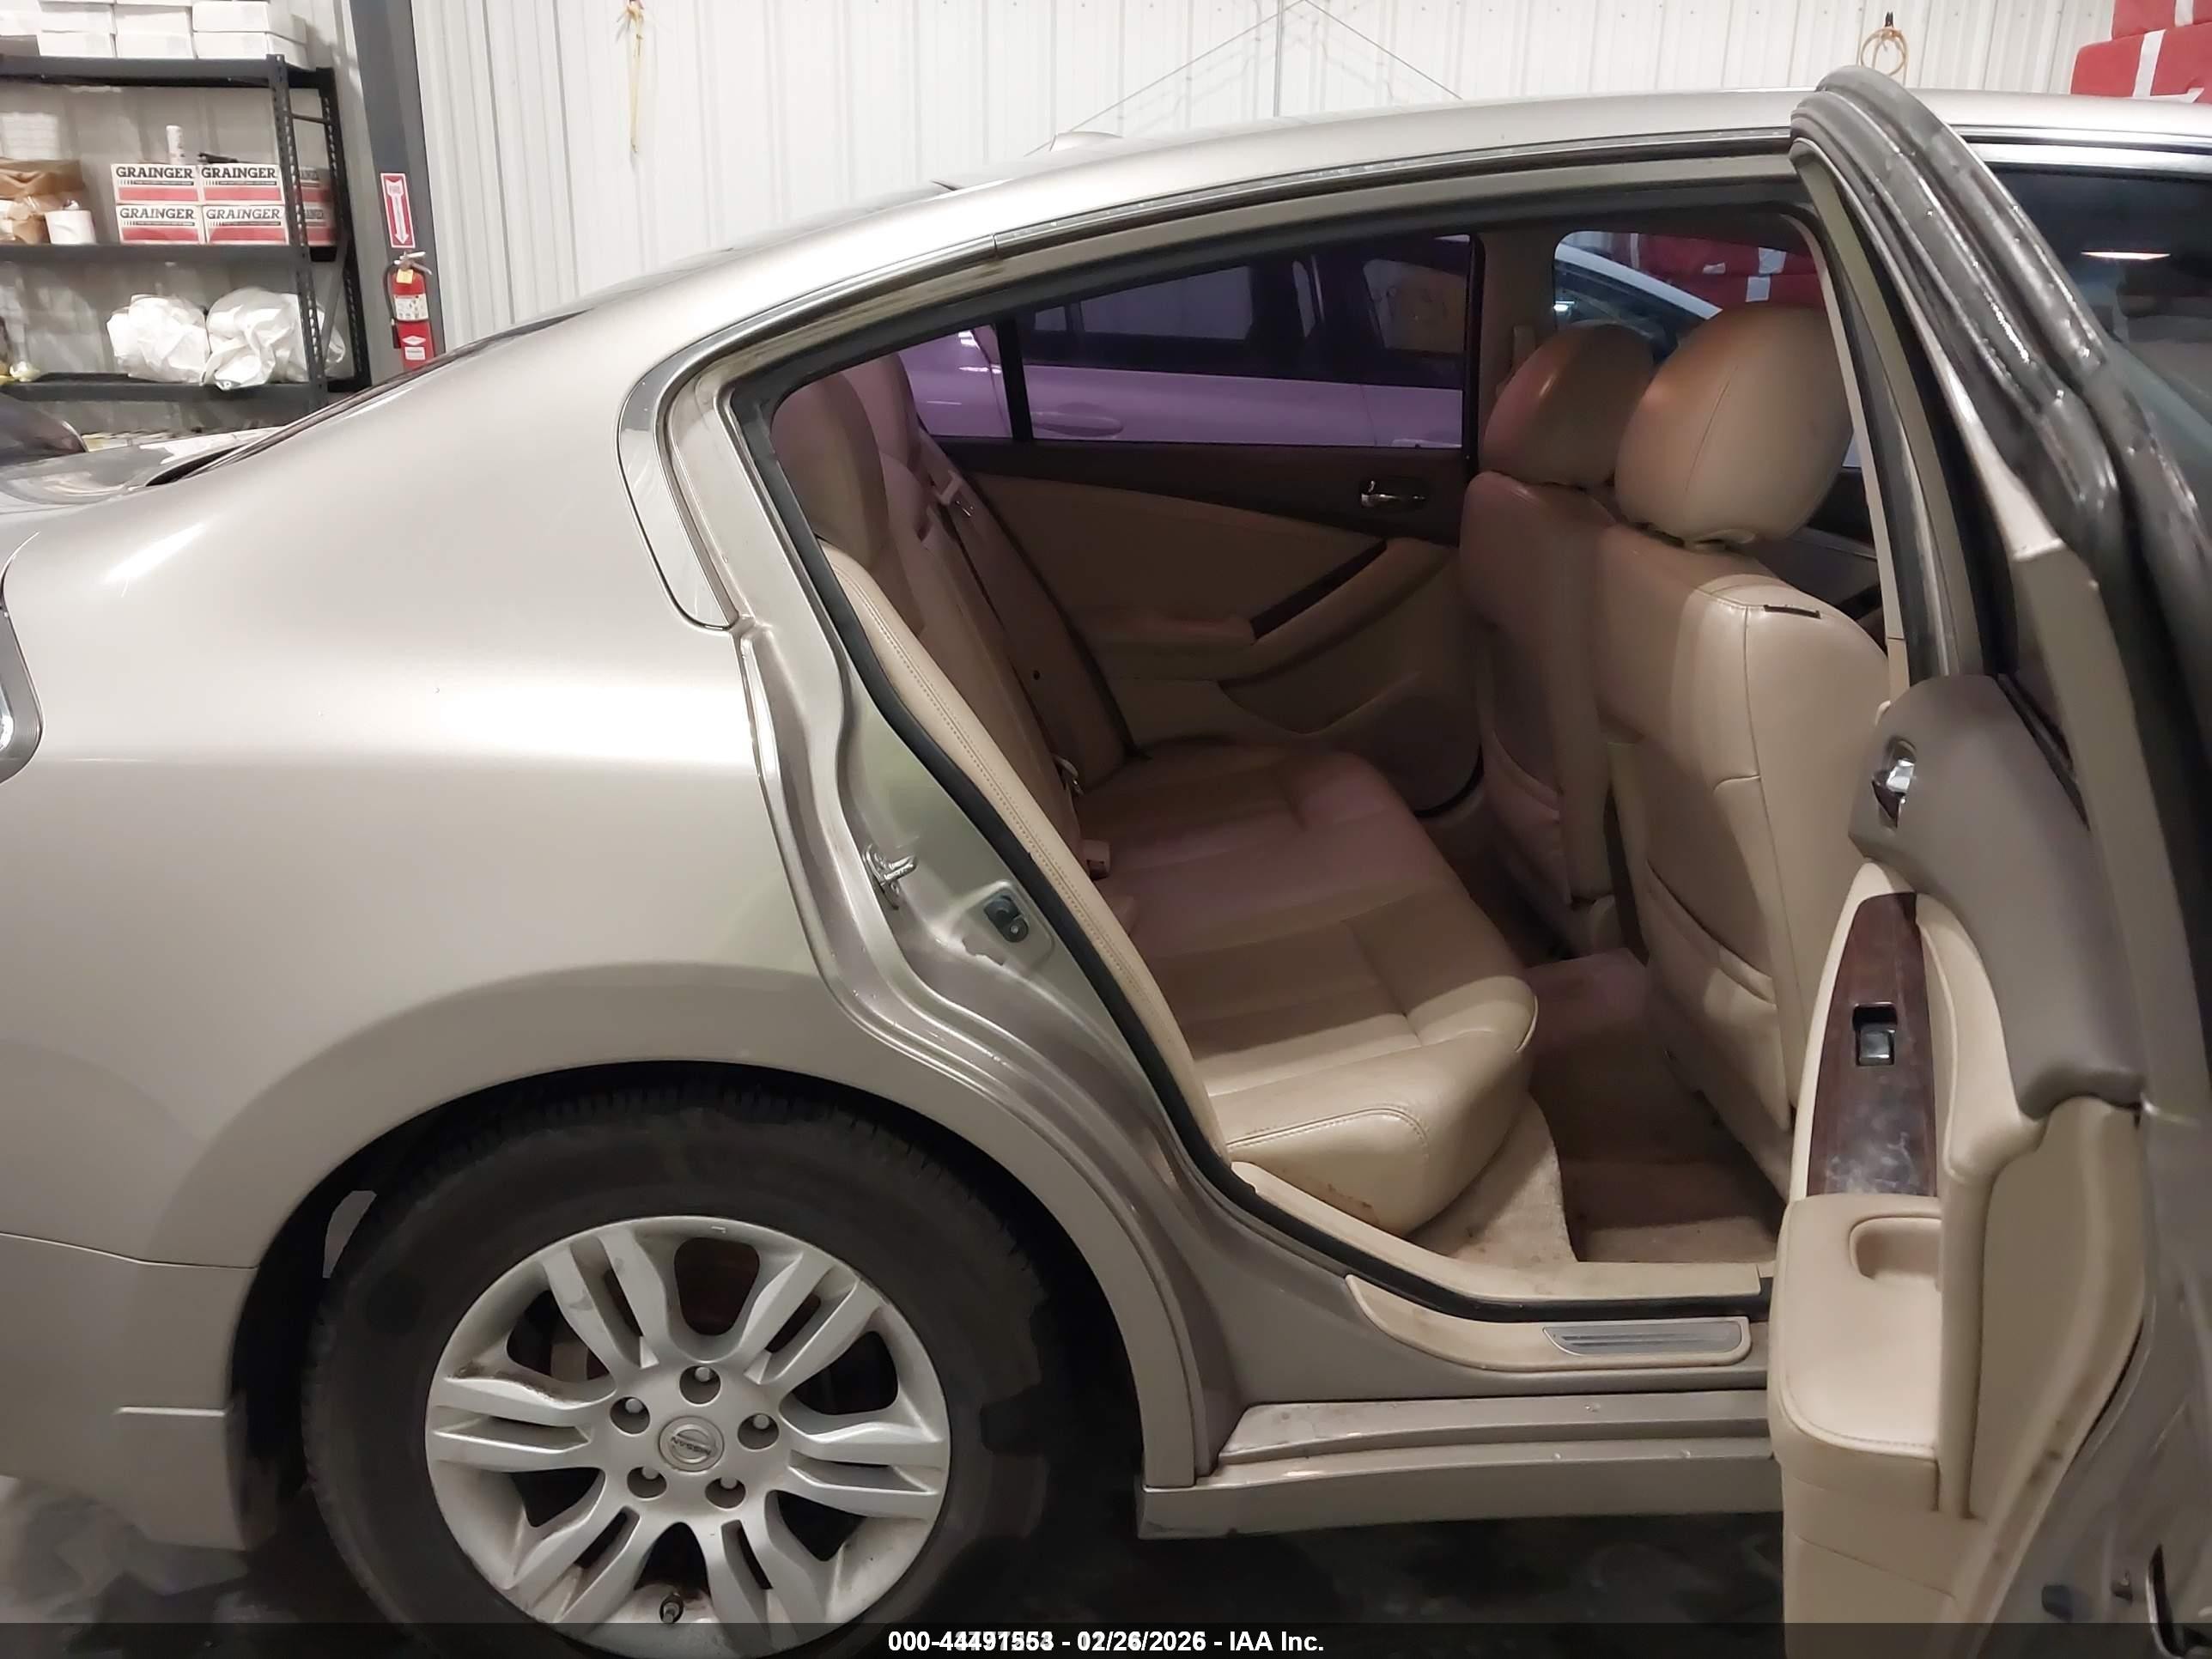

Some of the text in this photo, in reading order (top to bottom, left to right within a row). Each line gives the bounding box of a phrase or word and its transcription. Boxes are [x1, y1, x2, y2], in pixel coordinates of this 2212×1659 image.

[116, 167, 193, 179] GRAINGER
[201, 167, 276, 179] GRAINGER
[120, 208, 195, 219] GRAINGER
[206, 209, 280, 220] GRAINGER
